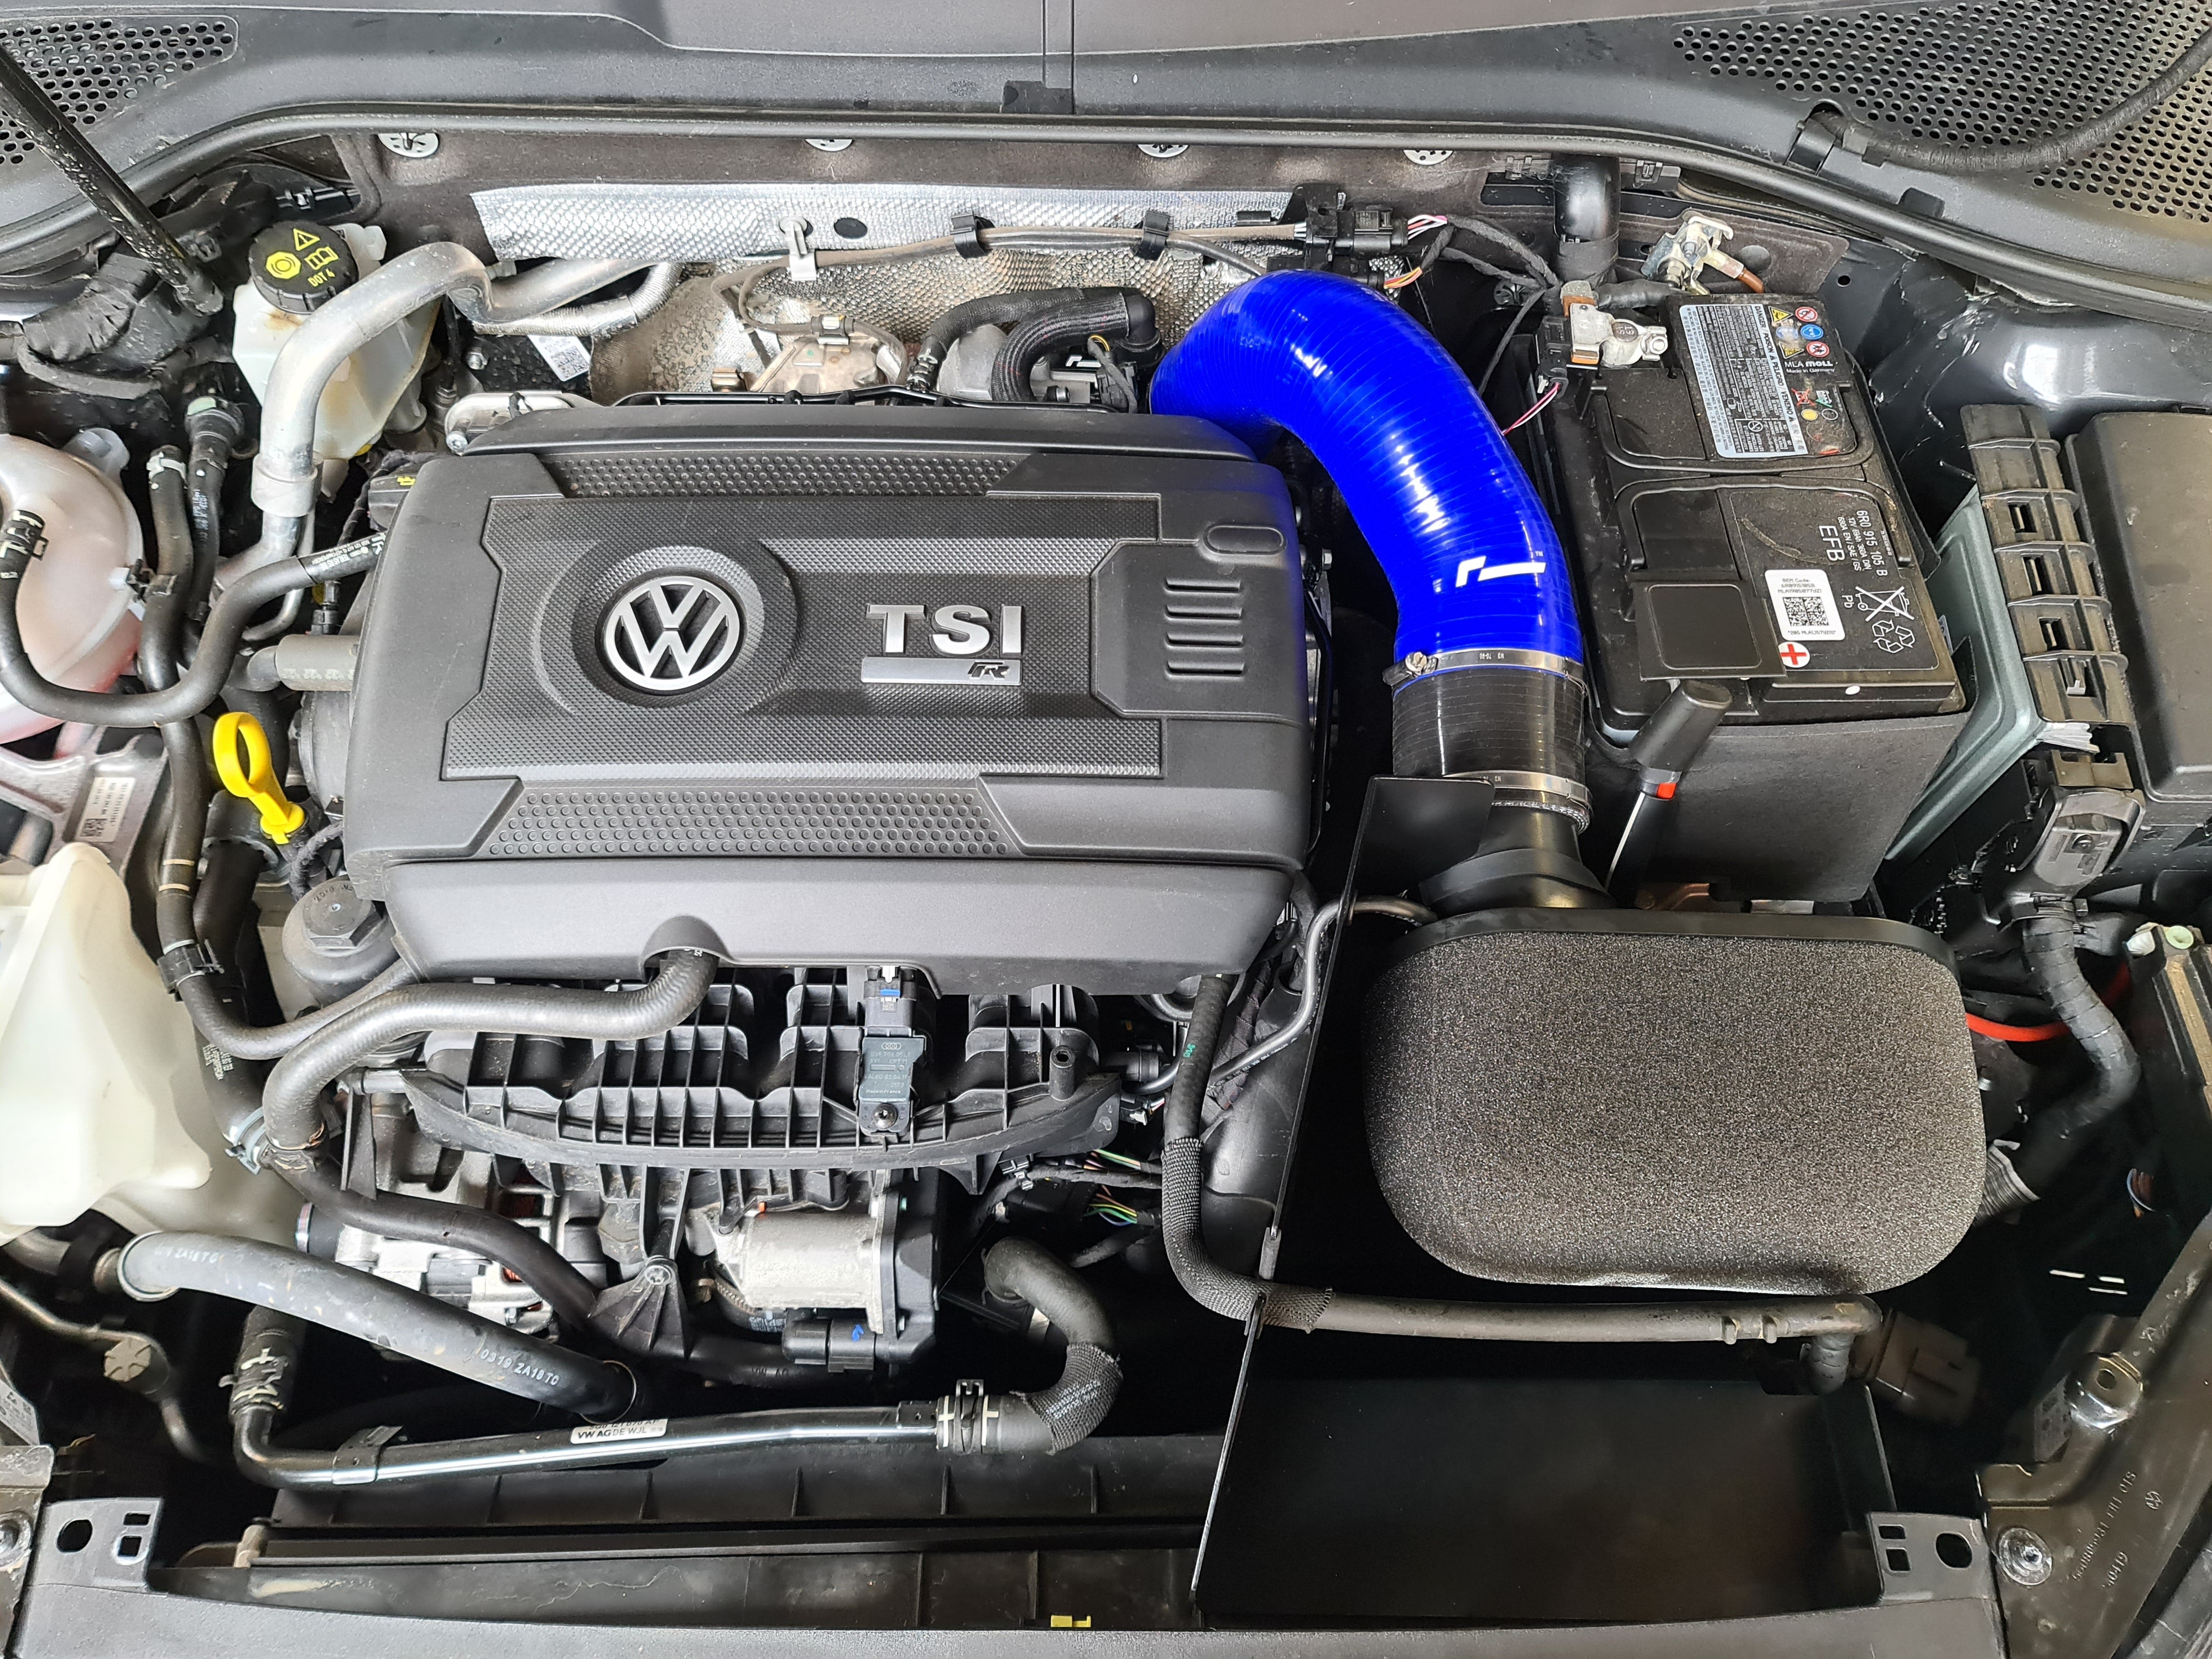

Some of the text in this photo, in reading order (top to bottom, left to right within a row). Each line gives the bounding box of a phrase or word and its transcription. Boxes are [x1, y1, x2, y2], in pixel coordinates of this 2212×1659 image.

[307, 272, 328, 287] DOT
[1755, 306, 1768, 327] DANGER
[1762, 333, 1775, 353] POISON
[1771, 362, 1785, 385] PELIGRO
[1780, 391, 1793, 414] VENENO
[1856, 510, 1871, 527] 6R0
[1819, 525, 1845, 561] EFB
[1848, 518, 1858, 527] 12V
[1862, 560, 1872, 570] DIN
[1863, 531, 1878, 546] 915
[1870, 551, 1885, 565] 105
[1841, 595, 1855, 608] Pb
[604, 575, 741, 692] VW
[866, 603, 1022, 658] TSI
[578, 1431, 594, 1439] VW
[628, 1426, 646, 1434] WJL
